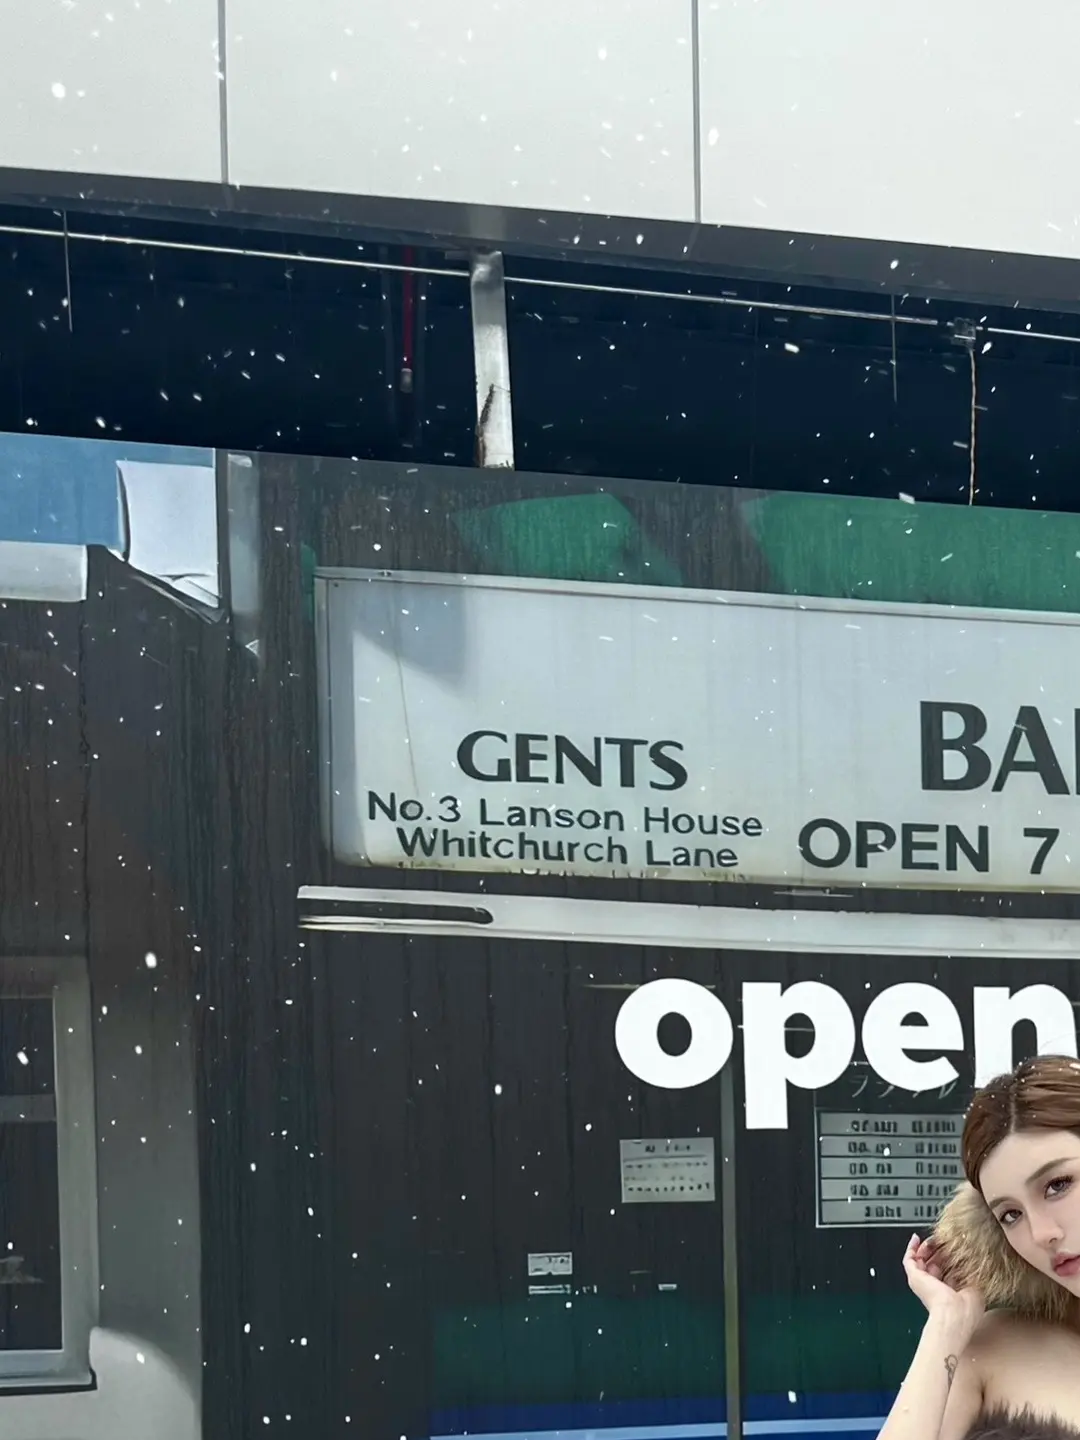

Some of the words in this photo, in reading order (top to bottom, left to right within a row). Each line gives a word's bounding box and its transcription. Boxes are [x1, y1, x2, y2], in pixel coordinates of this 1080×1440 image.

[457, 731, 688, 790] GENTS
[368, 791, 461, 822] No.3
[480, 799, 624, 832] Lanson
[645, 807, 763, 837] House
[397, 827, 628, 866] Whitchurch
[646, 832, 740, 868] Lane
[799, 818, 989, 872] OPEN
[1024, 828, 1059, 875] 7
